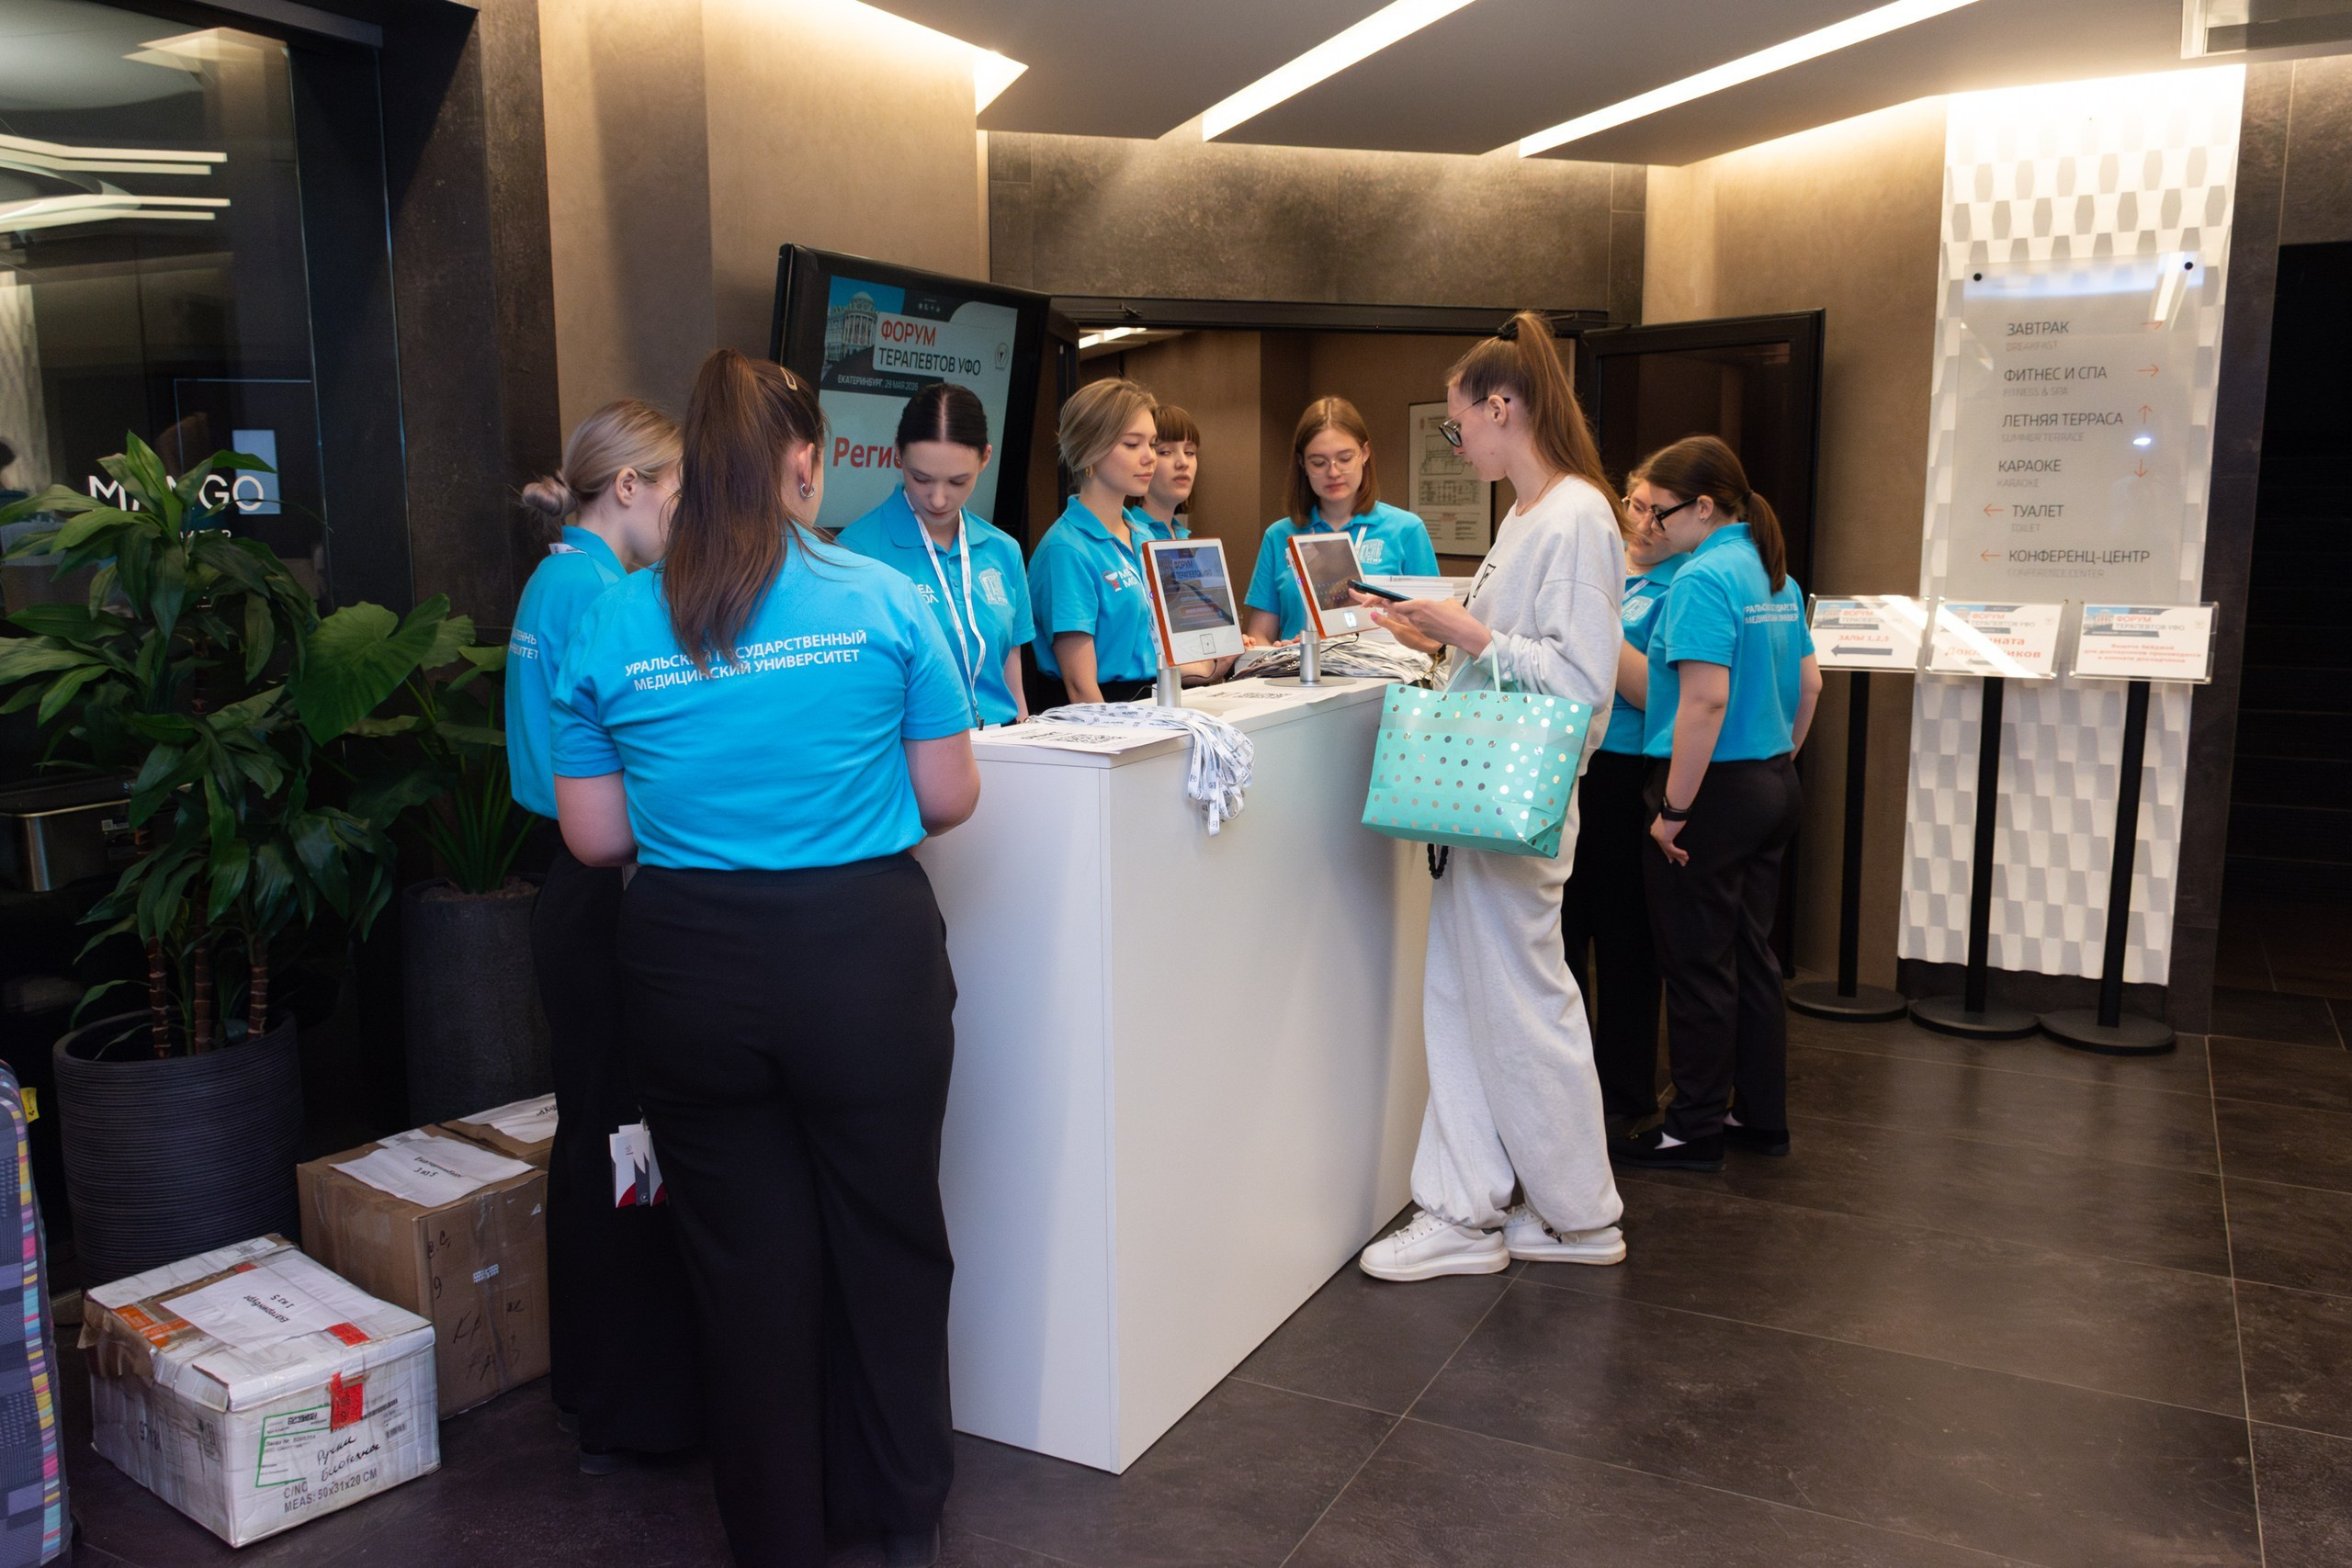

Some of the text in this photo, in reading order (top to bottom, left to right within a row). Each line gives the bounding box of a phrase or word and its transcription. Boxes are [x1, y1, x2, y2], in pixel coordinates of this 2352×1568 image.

[881, 320, 936, 347] ФОРУМ
[2007, 321, 2070, 336] ЗАВТРАК
[878, 347, 981, 376] ТЕРАПЕВТОВ УФО
[2004, 366, 2108, 381] ФИТНЕС И СПА
[2001, 412, 2124, 428] ЛЕТНЯЯ ТЕРРАСА
[1998, 458, 2062, 472] КАРАОКЕ
[88, 474, 264, 511] MGO
[2012, 504, 2065, 517] ТУАЛЕТ
[2008, 549, 2151, 564] КОНФЕРЕНЦ-ЦЕНТР
[754, 649, 861, 672] УНИВЕРСИТЕТ
[284, 1493, 316, 1513] MEAS:
[363, 1468, 378, 1482] CM
